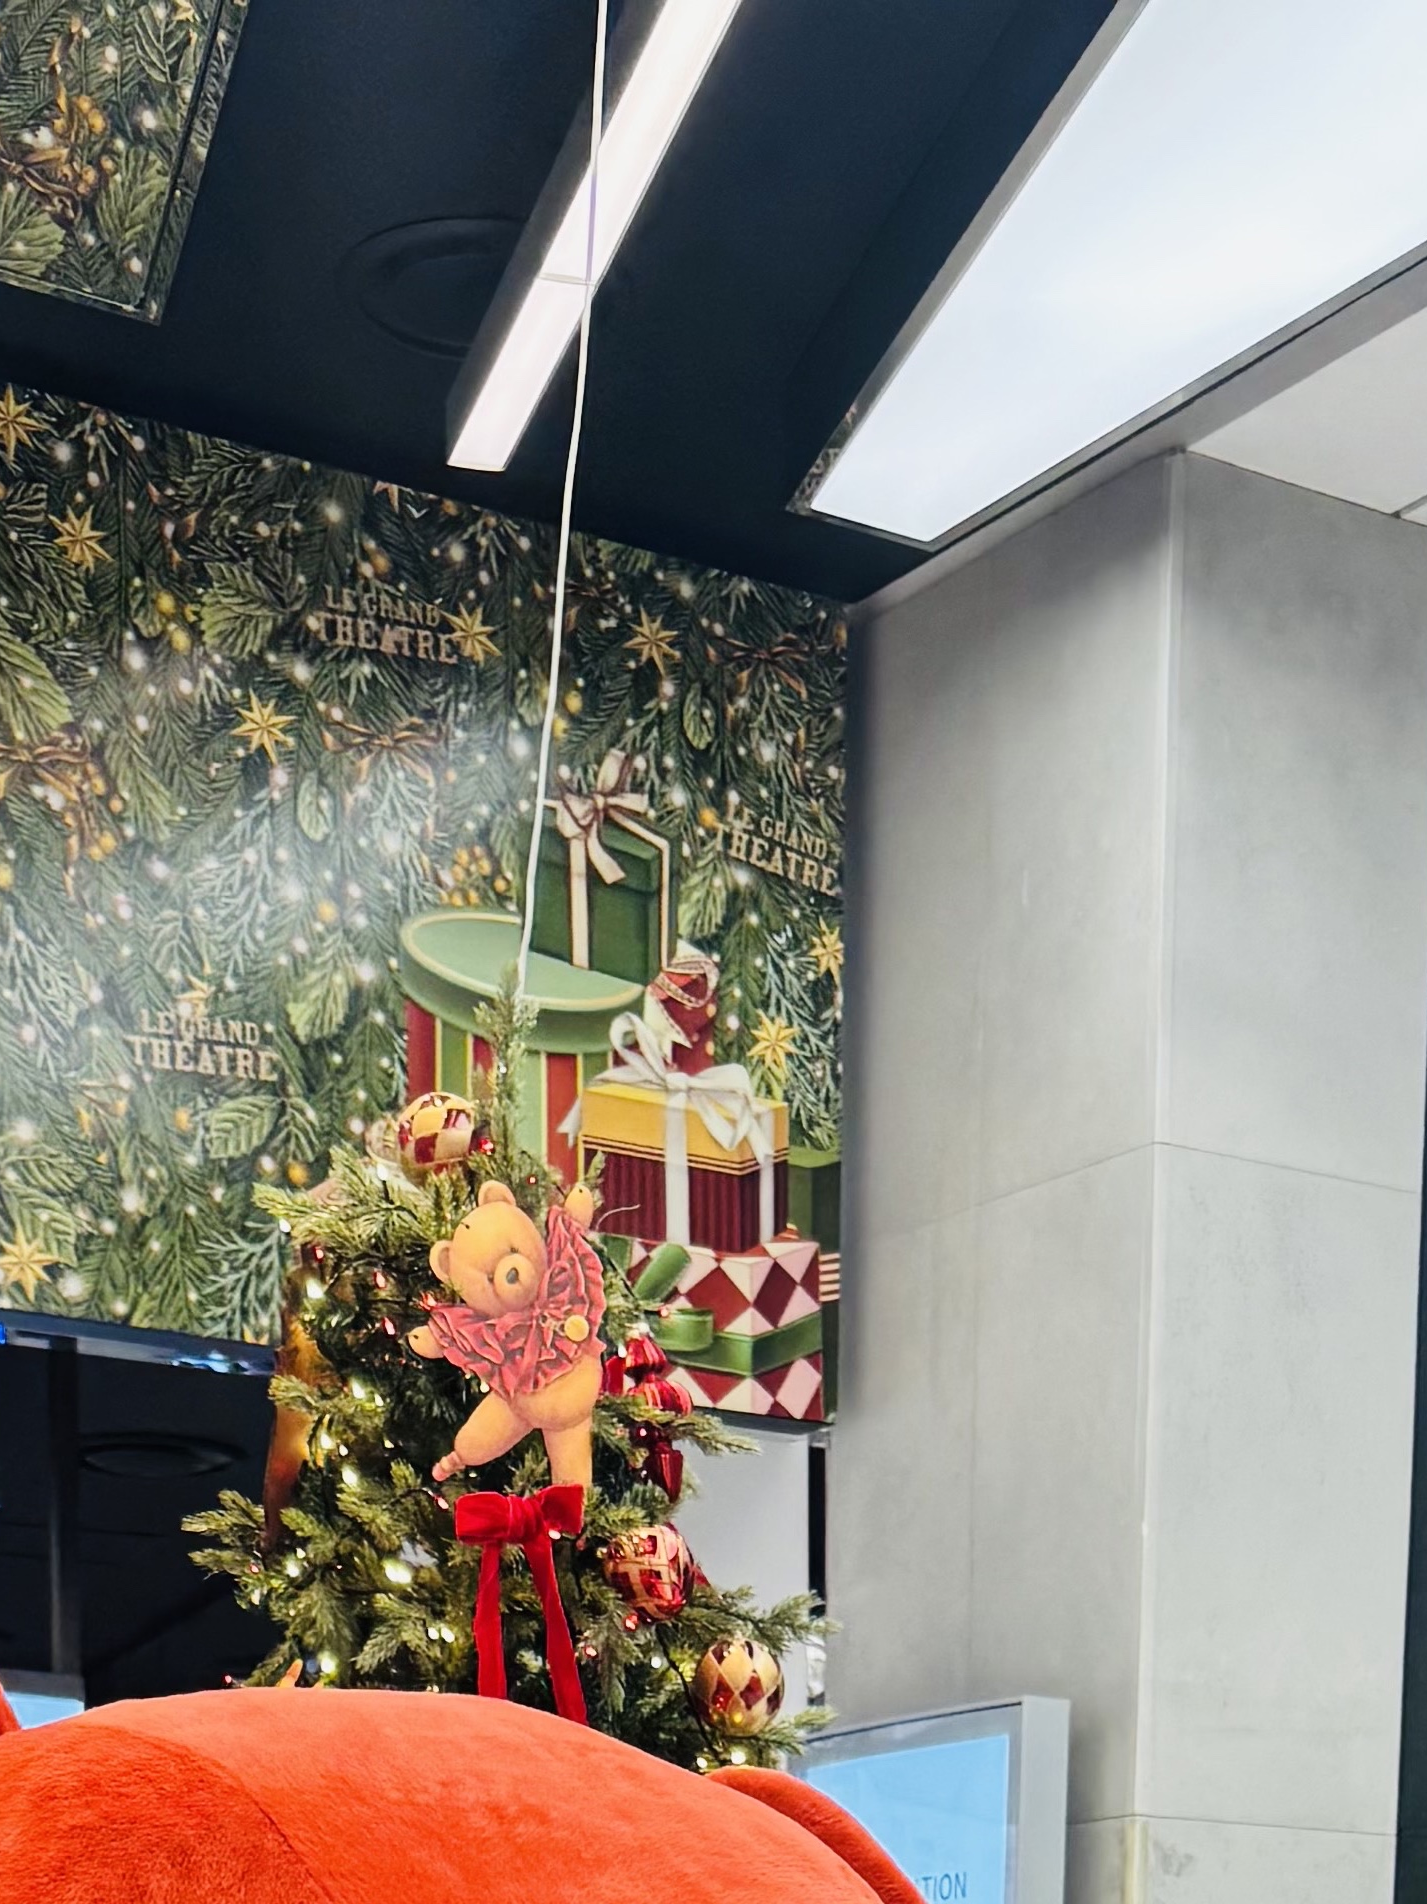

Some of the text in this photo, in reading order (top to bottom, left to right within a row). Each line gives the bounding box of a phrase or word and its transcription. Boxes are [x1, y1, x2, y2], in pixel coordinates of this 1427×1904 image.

[362, 589, 440, 628] GRAND
[312, 610, 459, 665] THEATRE
[714, 823, 841, 897] THEATRE
[759, 815, 828, 861] GRAND
[139, 1008, 260, 1047] LE GRAND
[123, 1034, 282, 1083] THEATRE
[915, 1871, 968, 1901] TION
